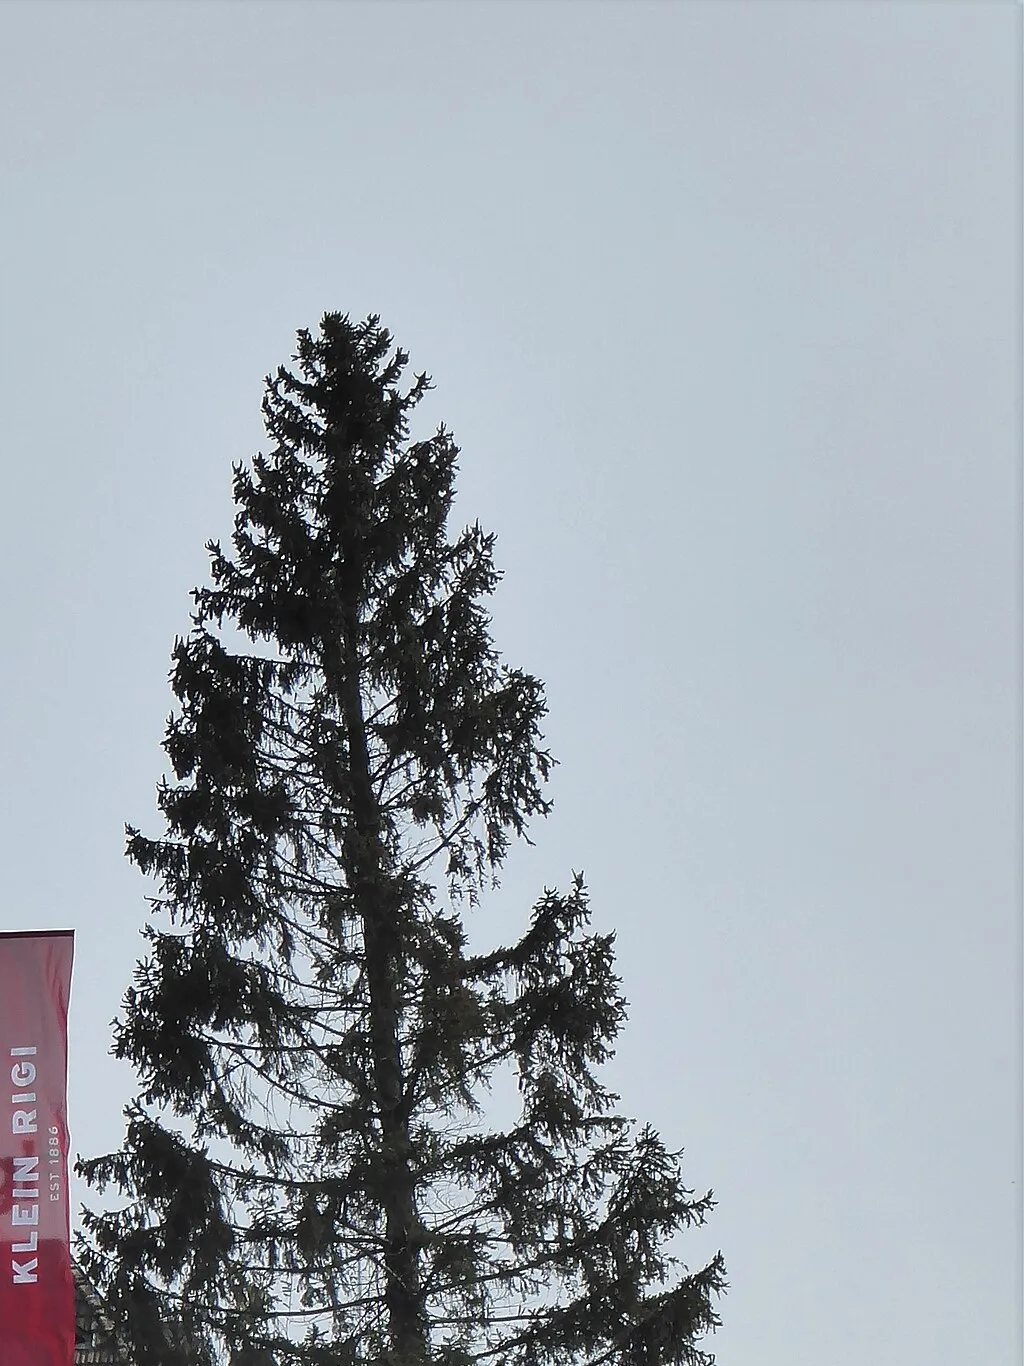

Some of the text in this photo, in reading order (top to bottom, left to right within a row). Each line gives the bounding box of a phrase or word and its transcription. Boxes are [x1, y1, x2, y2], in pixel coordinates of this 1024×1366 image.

[10, 1046, 40, 1284] KLEIN RIGI
[48, 1126, 61, 1201] EST 1886
